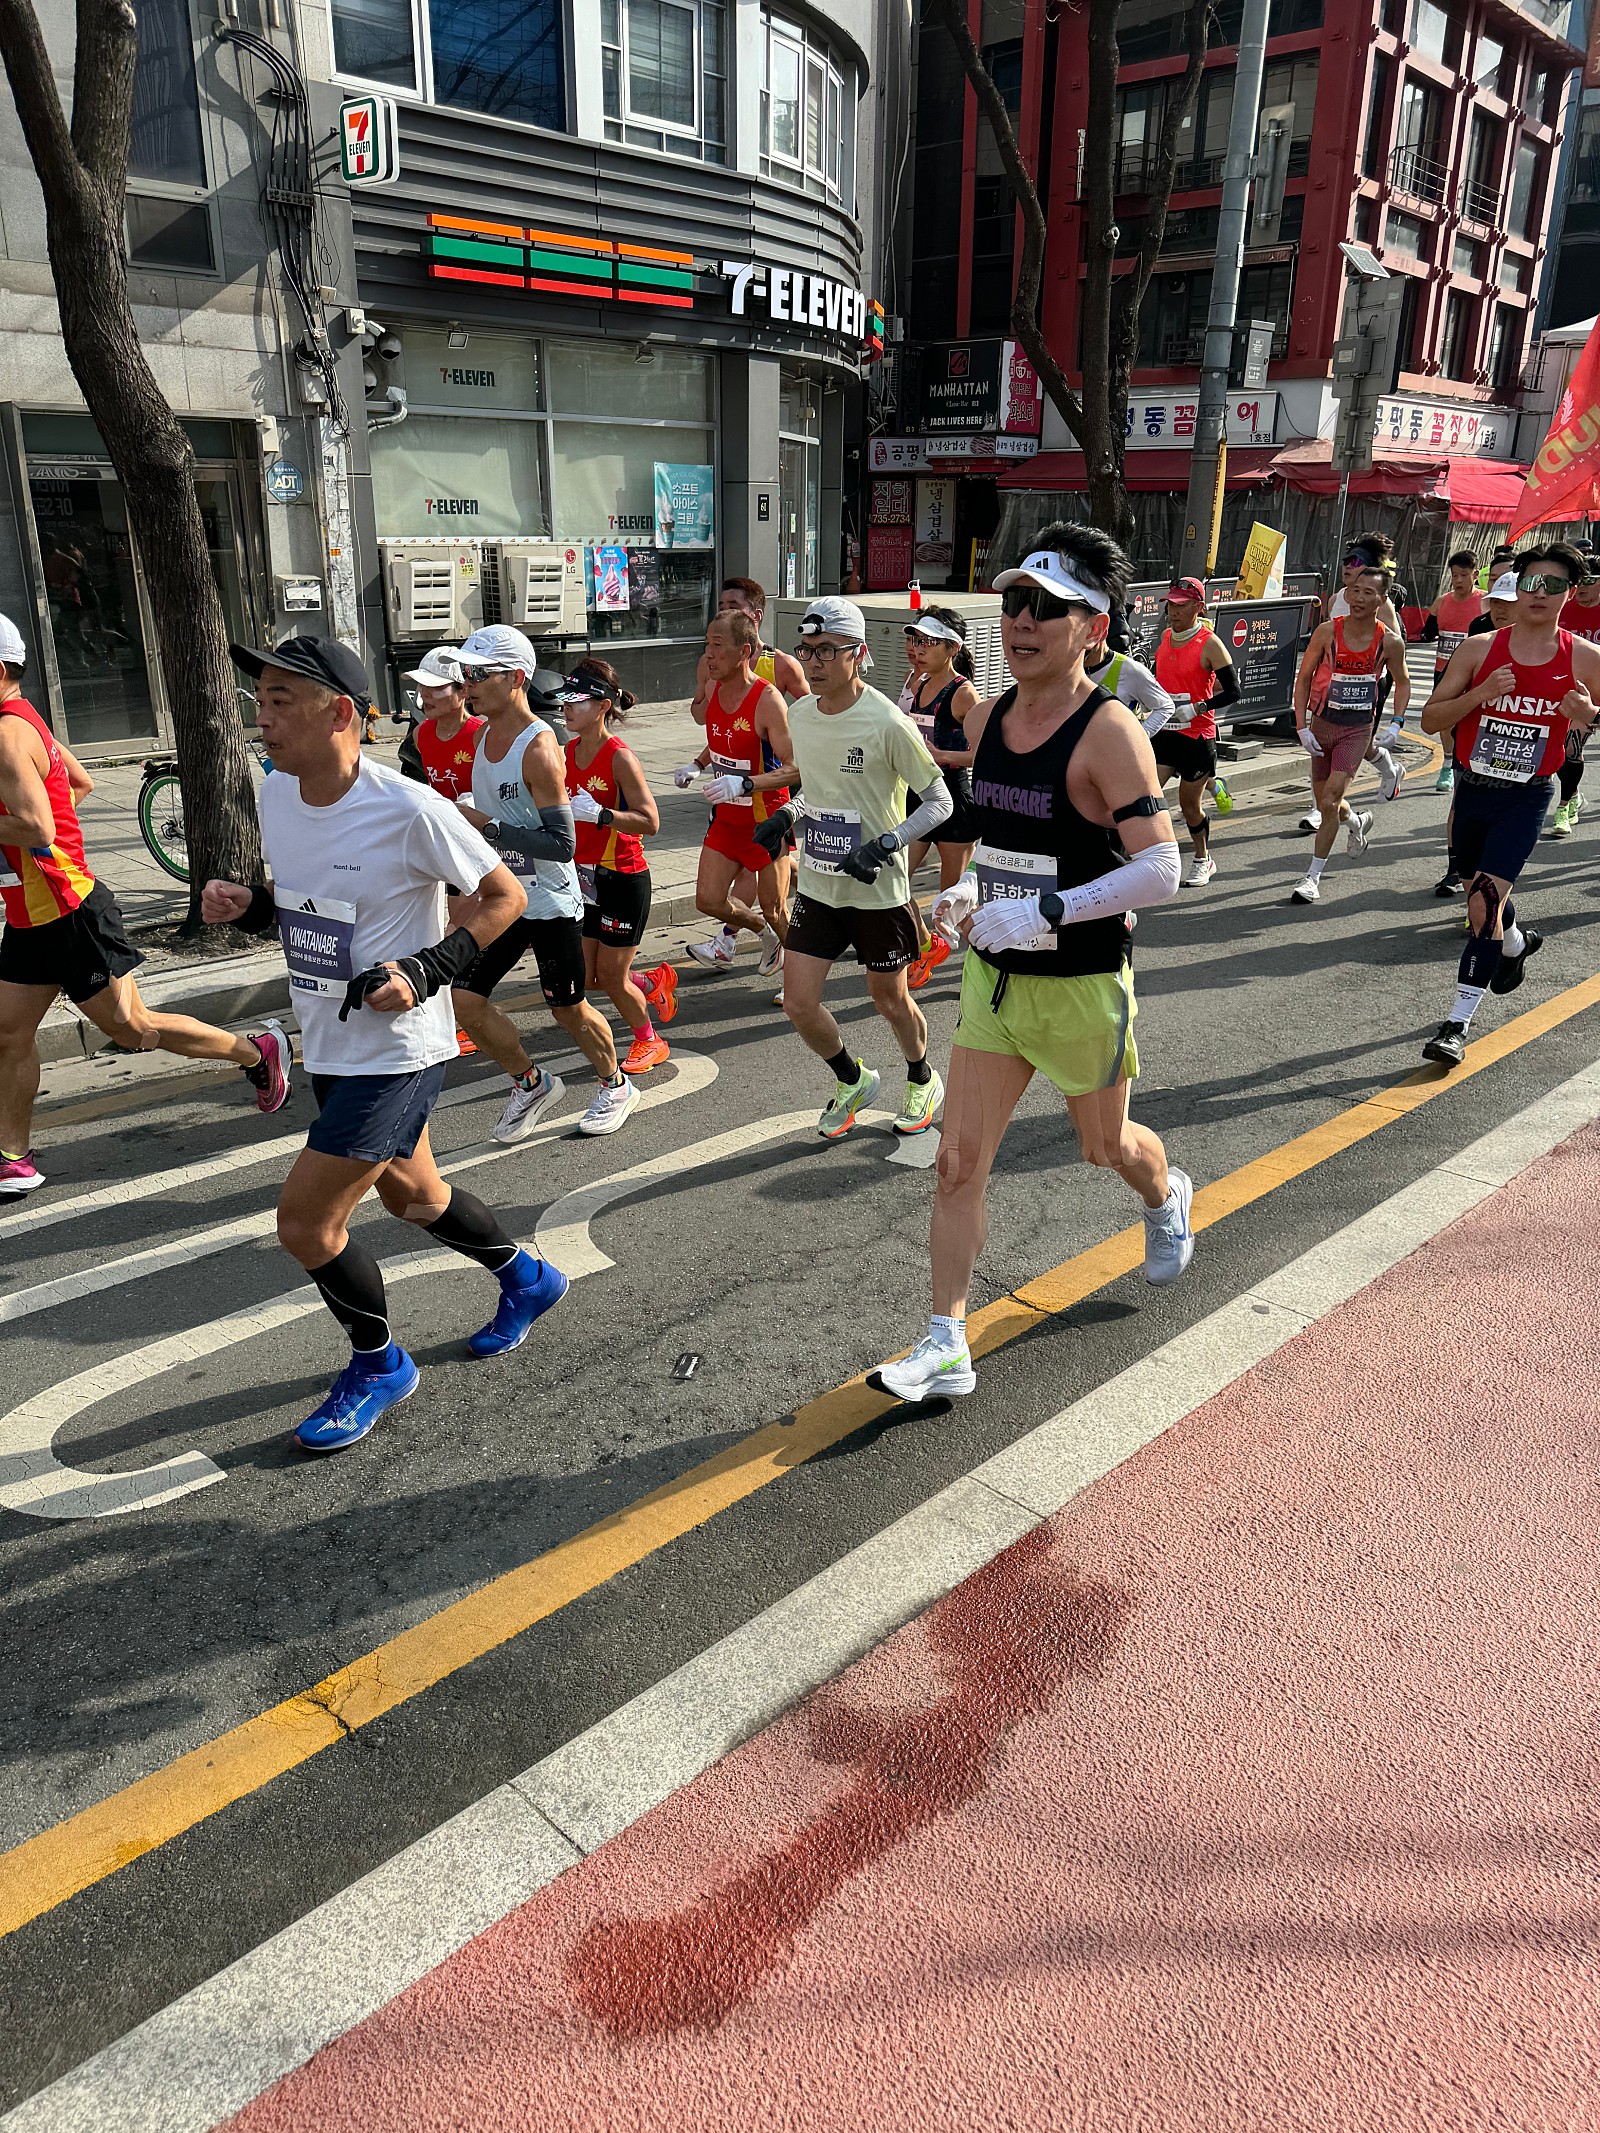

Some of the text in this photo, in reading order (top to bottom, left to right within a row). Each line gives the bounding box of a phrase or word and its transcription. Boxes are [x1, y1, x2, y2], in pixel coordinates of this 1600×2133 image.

[348, 110, 369, 174] 7
[349, 140, 370, 156] ELEVEN
[722, 260, 866, 340] 7-ELEVEN
[440, 367, 495, 387] 7-ELEVEN
[929, 380, 989, 398] MANHATTAN
[929, 416, 983, 426] JACK LIVES HERE
[936, 440, 967, 451] 냉삼겹살
[1249, 433, 1271, 443] 1호점
[892, 444, 926, 461] 공평
[273, 474, 298, 490] ADT
[672, 482, 699, 496] 소프트
[873, 481, 909, 498] 지하
[425, 498, 480, 515] 7-ELEVEN
[672, 497, 698, 511] 아이스
[874, 498, 909, 514] 임대
[607, 515, 653, 530] 7-ELEVEN
[676, 512, 695, 526] 크림
[873, 514, 911, 524] 735-2734
[927, 488, 945, 542] 냉삼겹살
[566, 566, 576, 575] LG
[1342, 687, 1369, 697] 정병규
[1489, 722, 1536, 740] MNSIX
[1480, 738, 1536, 758] C 김규성
[847, 755, 864, 767] 100
[974, 779, 1053, 818] OPENCARE
[995, 854, 1035, 869] KB금융그룹
